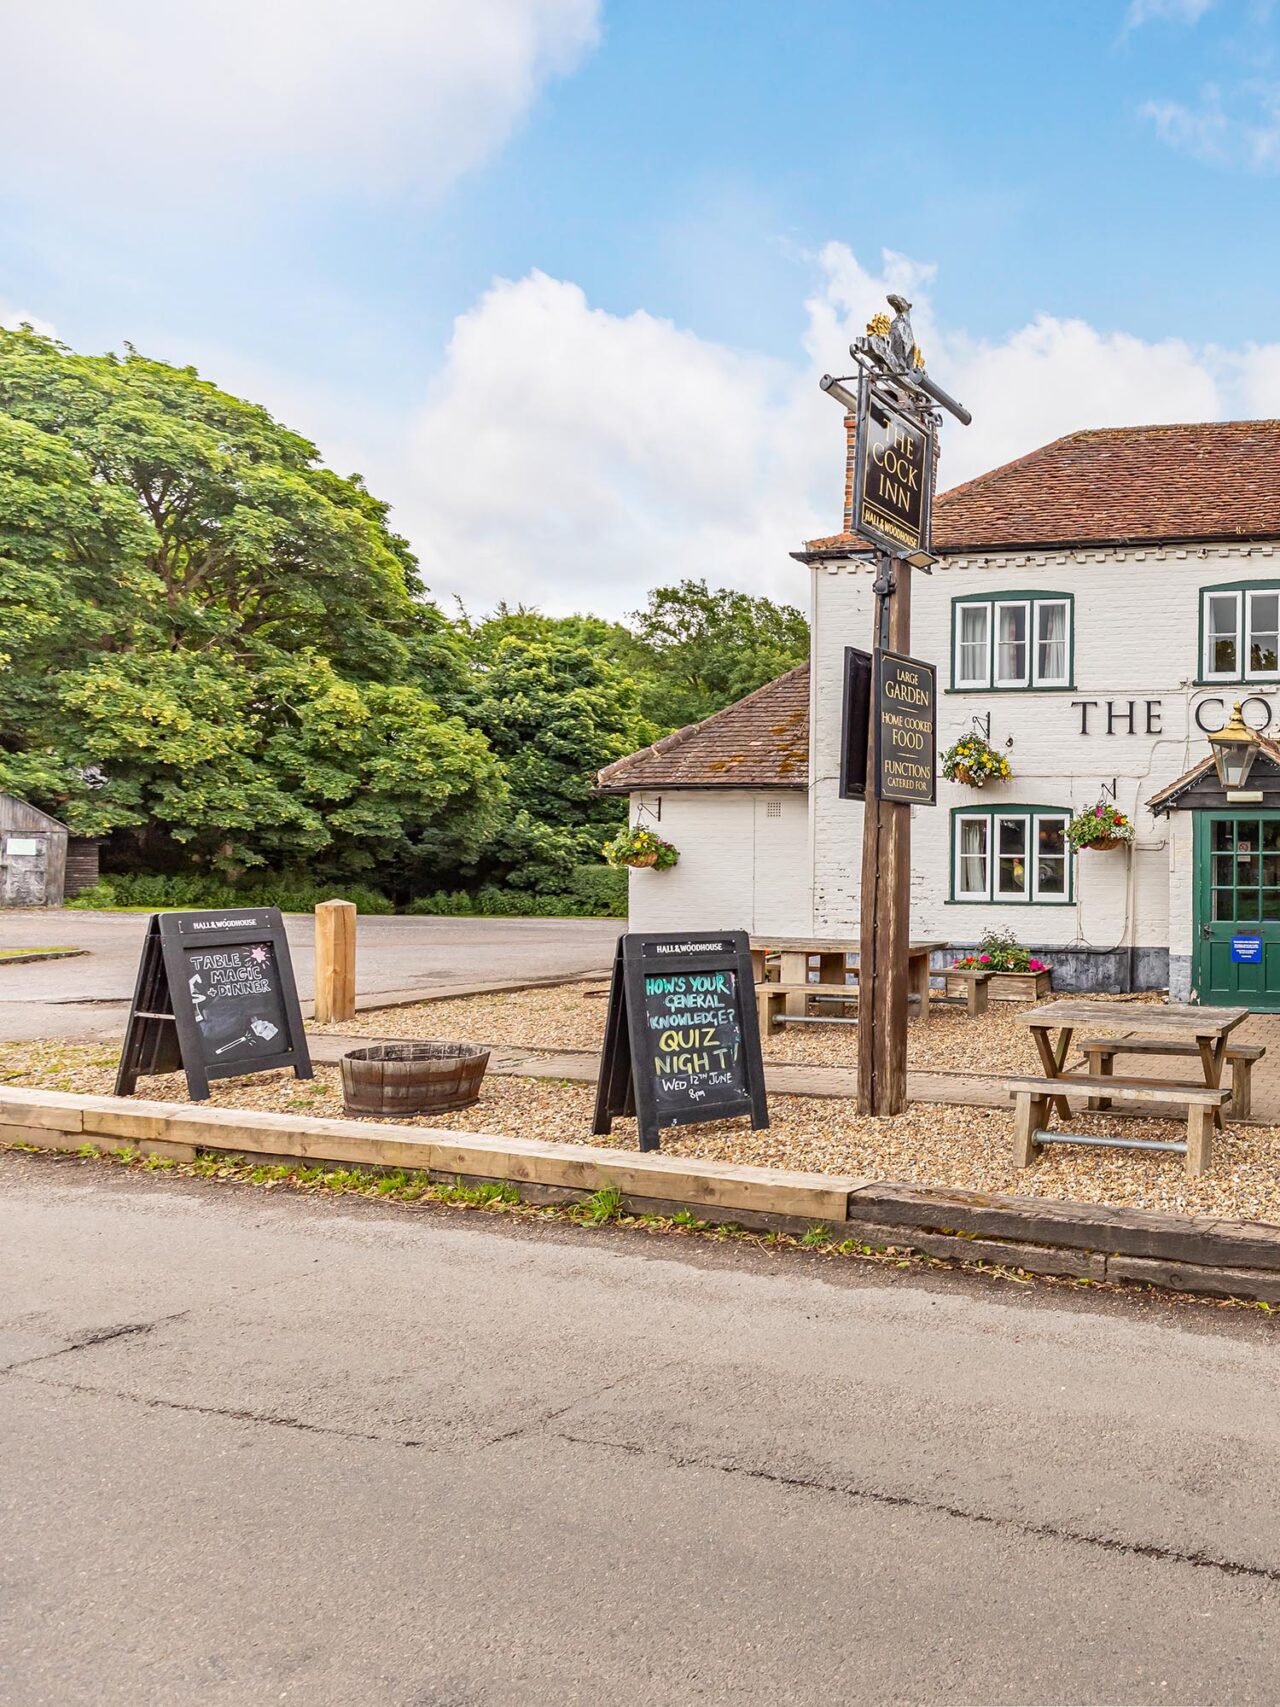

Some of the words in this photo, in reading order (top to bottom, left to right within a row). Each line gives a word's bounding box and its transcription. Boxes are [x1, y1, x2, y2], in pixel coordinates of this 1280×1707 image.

[883, 418, 914, 460] THE
[873, 443, 918, 491] COCK
[878, 473, 911, 513] INN
[896, 668, 919, 685] LARGE
[885, 680, 929, 706] GARDEN
[881, 712, 903, 727] HOME
[904, 717, 933, 734] COOKED
[1070, 699, 1164, 736] THE
[892, 729, 924, 750] FOOD
[885, 760, 930, 779] FUNCTIONS
[887, 776, 914, 789] CATERED
[915, 781, 928, 792] FOR
[190, 953, 241, 970] TABLE
[210, 966, 262, 983] MAGIC
[646, 977, 686, 995] HOW'S
[690, 976, 730, 994] YOUR
[665, 993, 725, 1012] GENERAL
[649, 1009, 735, 1029] KNOWLEDGE?
[659, 1027, 721, 1052] QUIZ
[708, 1072, 733, 1086] JUNE
[688, 1088, 706, 1102] 8pm
